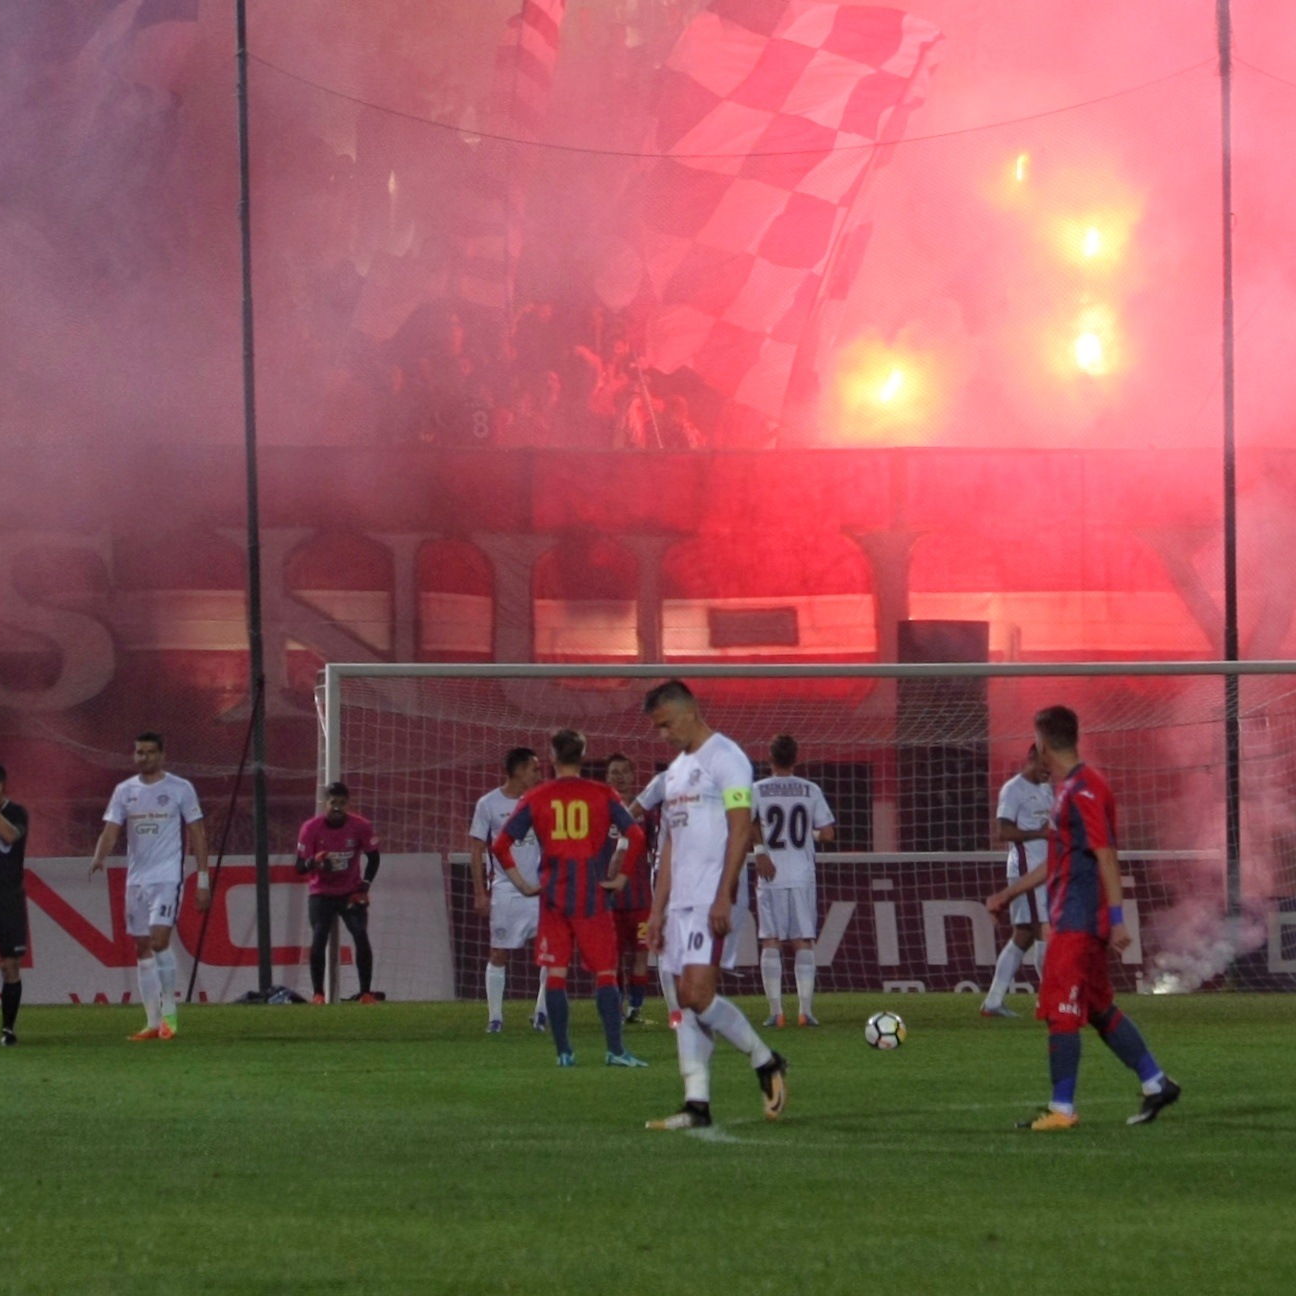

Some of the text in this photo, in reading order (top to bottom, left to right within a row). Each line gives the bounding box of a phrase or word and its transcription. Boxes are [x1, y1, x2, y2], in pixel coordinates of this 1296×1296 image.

[550, 800, 590, 840] 10
[767, 804, 808, 850] 20
[686, 931, 705, 951] 10
